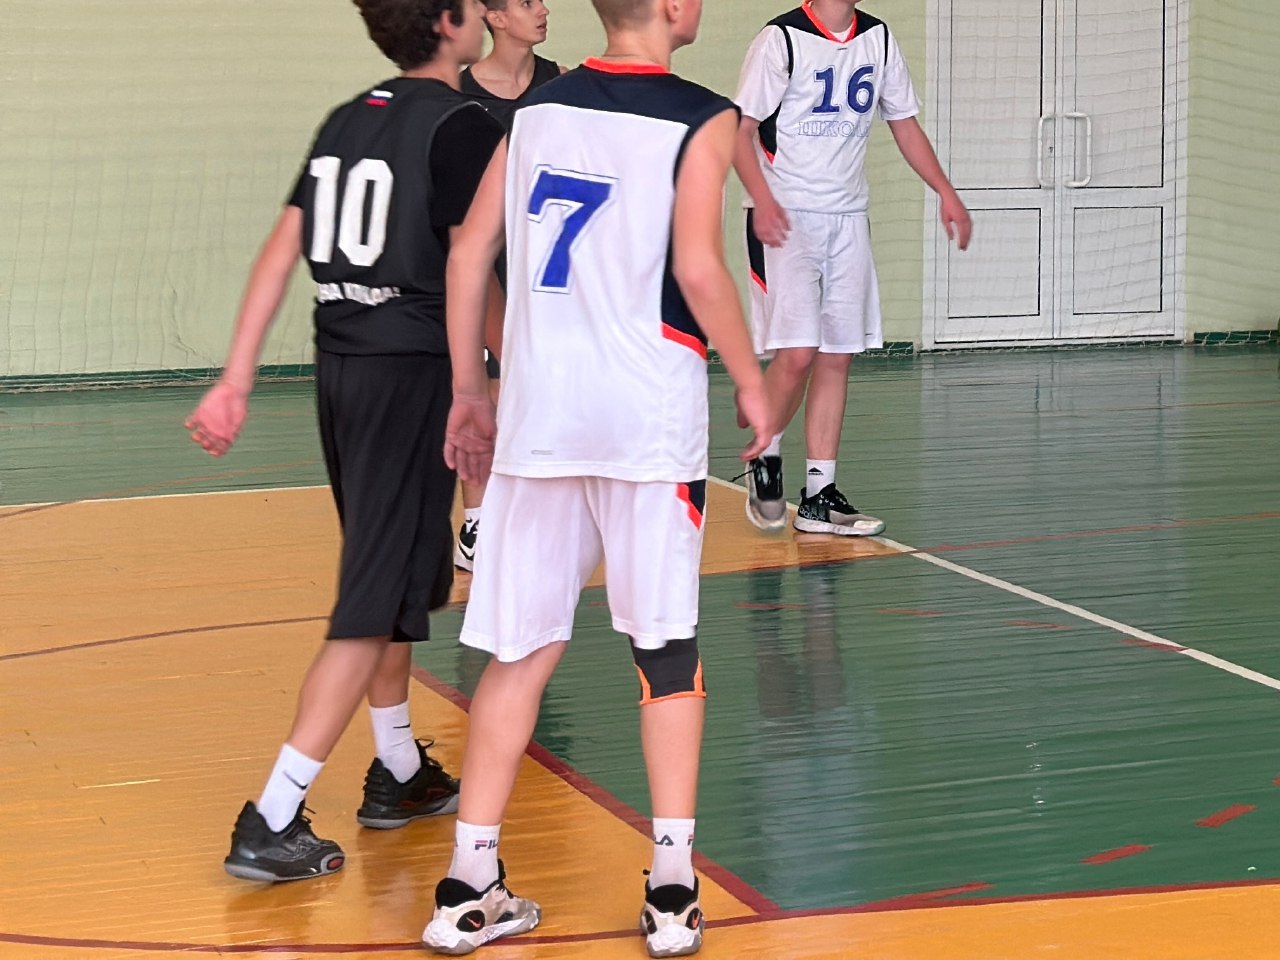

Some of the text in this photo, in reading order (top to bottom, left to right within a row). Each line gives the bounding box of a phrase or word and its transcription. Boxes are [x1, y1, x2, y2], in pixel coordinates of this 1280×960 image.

[811, 64, 875, 115] 16
[799, 121, 869, 138] ШКОЛ
[310, 156, 393, 267] 10
[528, 164, 619, 294] 7
[474, 839, 499, 851] FIL
